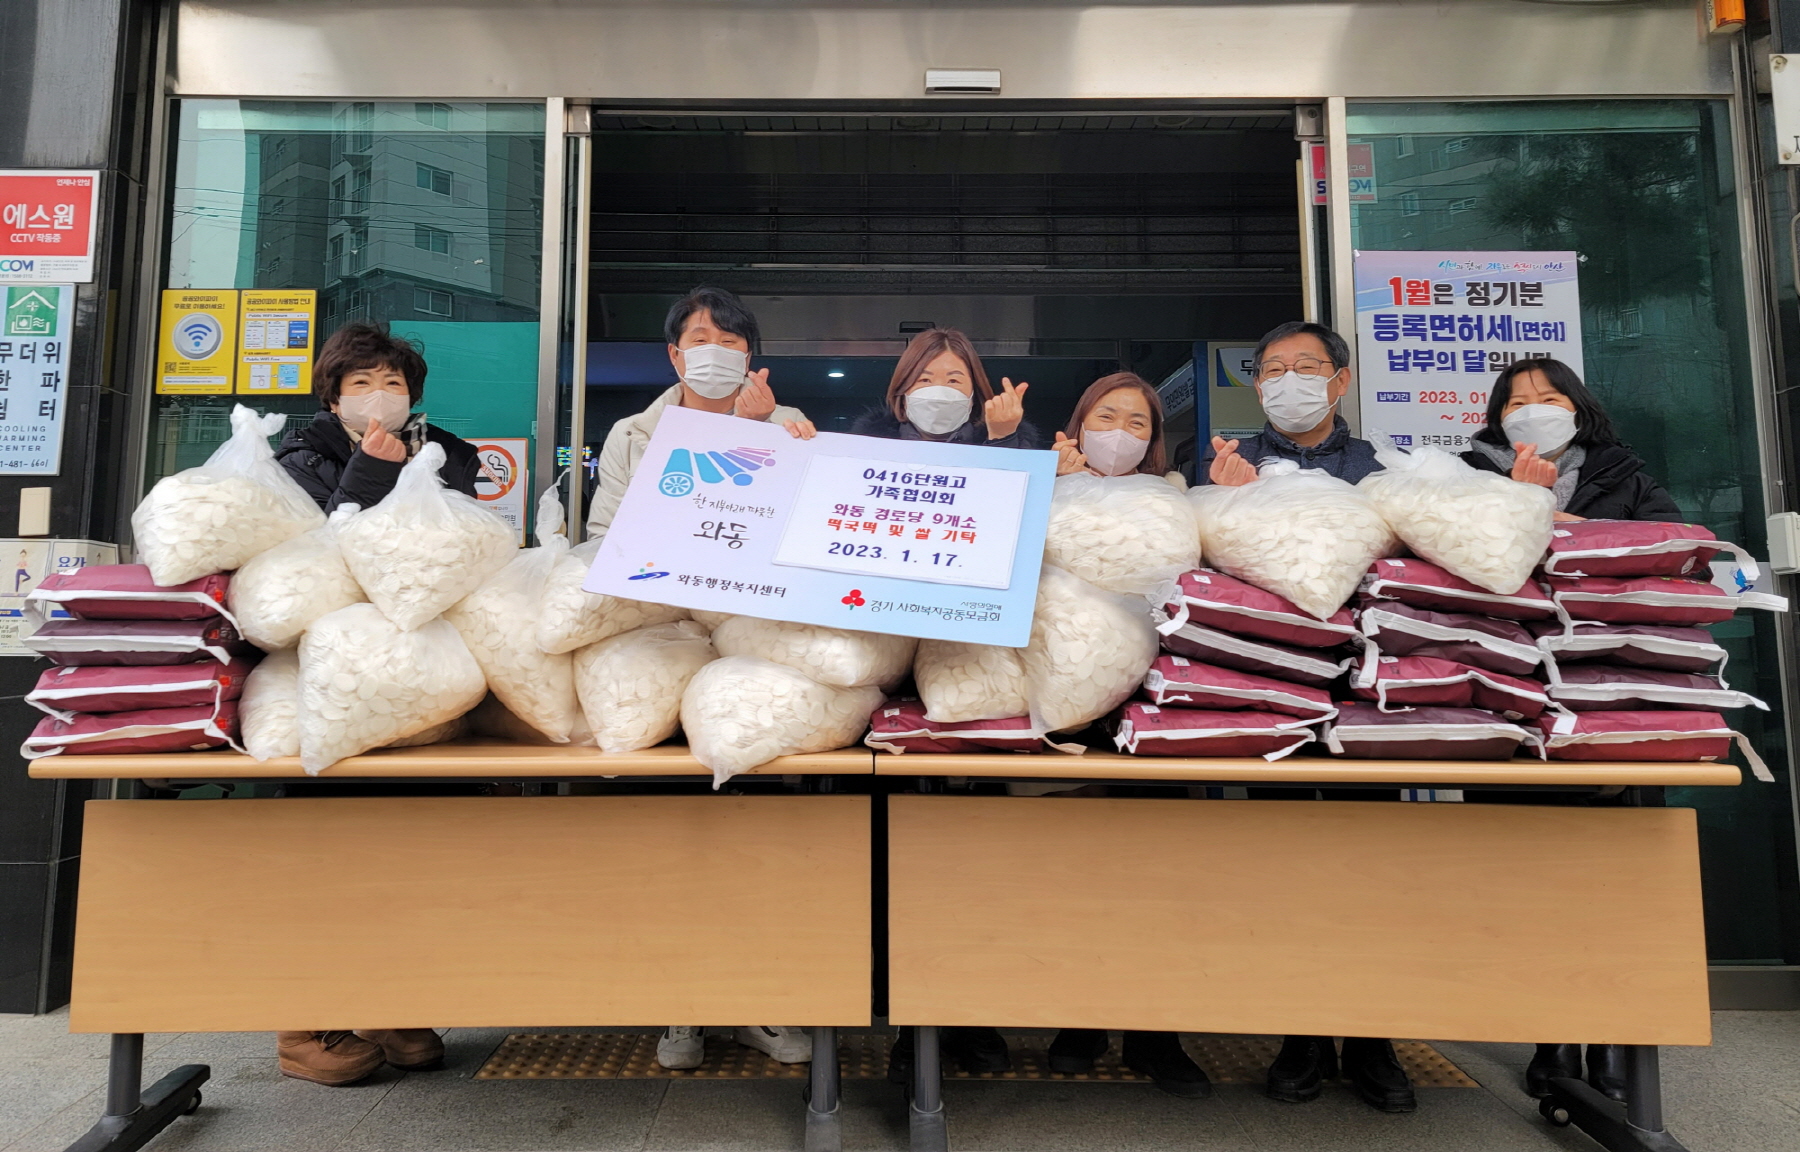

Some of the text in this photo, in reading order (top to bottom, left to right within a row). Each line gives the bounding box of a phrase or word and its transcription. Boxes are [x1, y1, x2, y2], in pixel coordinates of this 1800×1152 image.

[56, 178, 91, 187] 언제나 안심
[3, 203, 74, 230] 에스원
[10, 233, 62, 243] CCTV 작동중
[1388, 276, 1544, 307] 1월은 정기분
[1373, 313, 1566, 342] 등록면허세[면허]
[0, 341, 61, 364] 무더위
[1387, 349, 1457, 372] 납부의
[40, 370, 61, 393] 파
[1379, 393, 1410, 402] 납부기간
[1418, 390, 1463, 404] 2023.
[1461, 412, 1489, 424] 202
[862, 467, 967, 489] 0416단원고
[692, 492, 707, 509] 한
[865, 485, 956, 505] 가족협의회
[832, 503, 977, 529] 와동 경로당 9개소
[692, 520, 750, 549] 와동
[827, 518, 977, 544] 떡국떡 및 쌀 기탁
[57, 556, 87, 568] 요가
[828, 541, 963, 567] 2023. 1. 17.
[677, 574, 787, 598] 와동행정복지센터
[870, 599, 1001, 622] 경기 사회복지공동모금회
